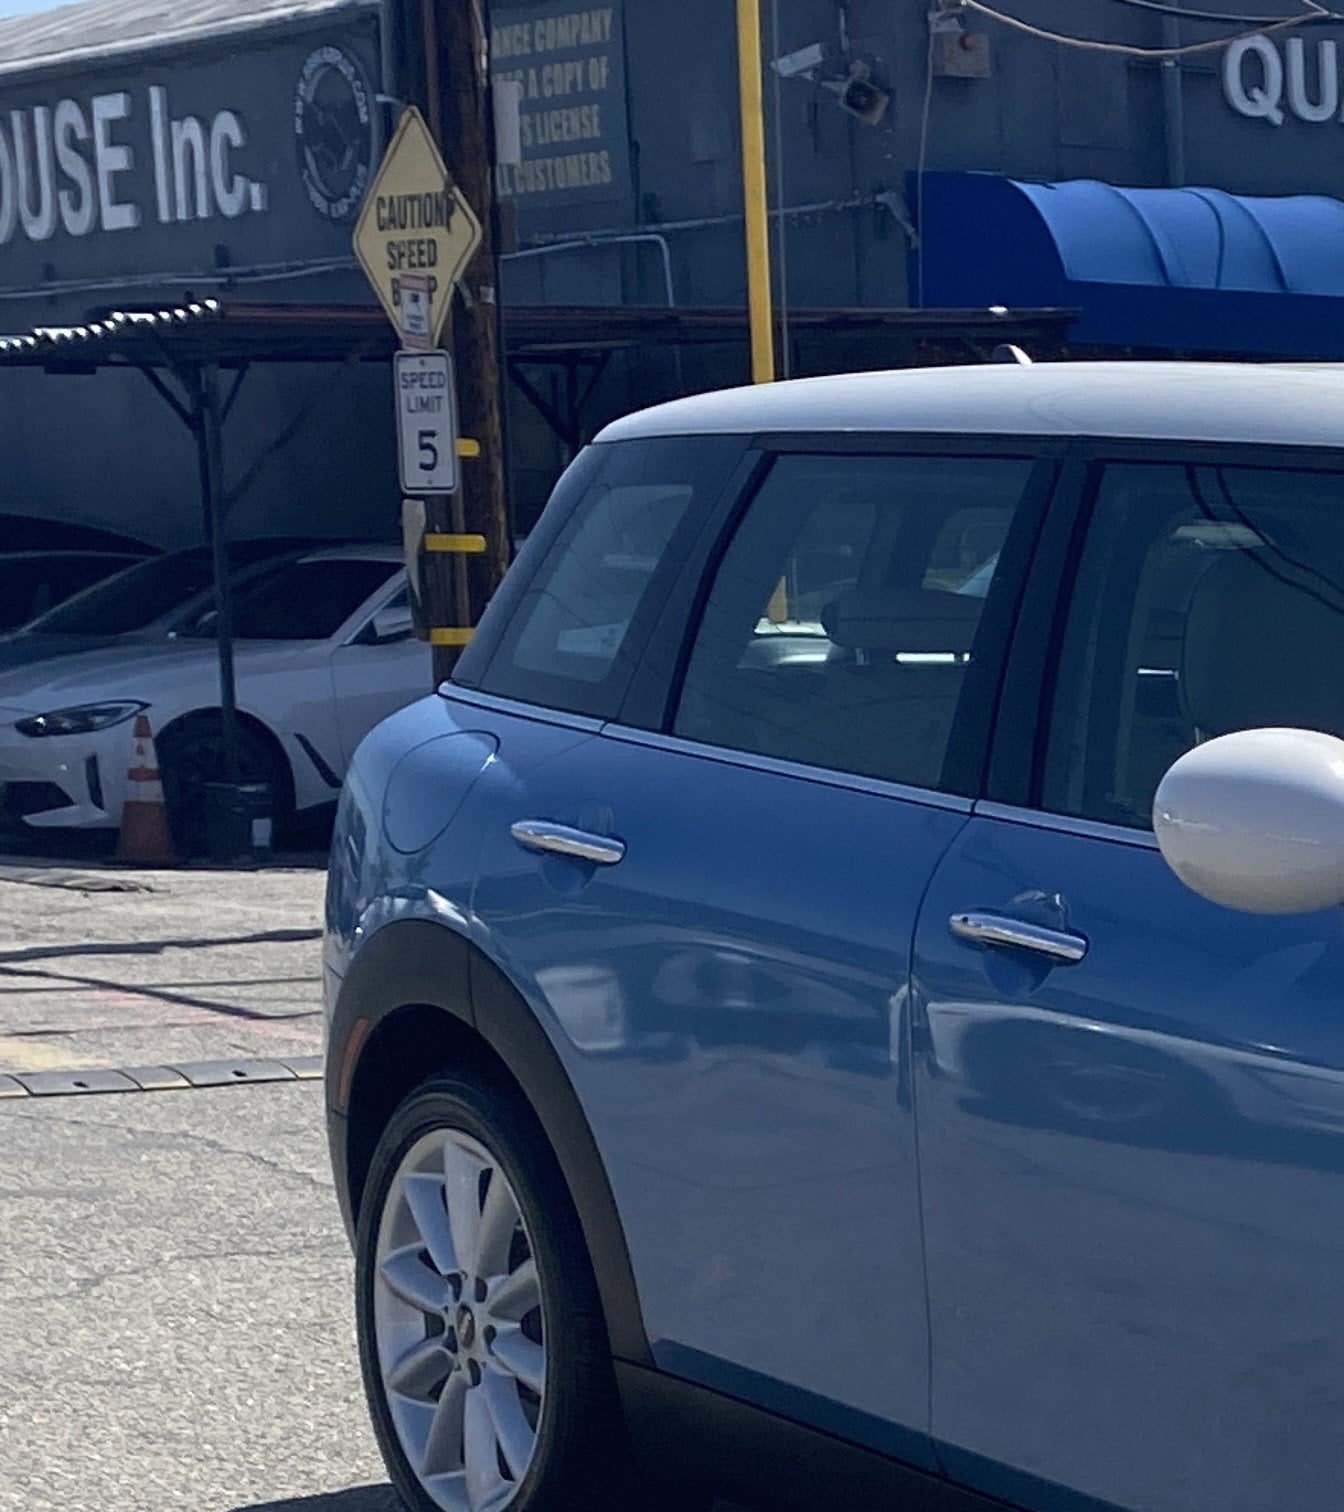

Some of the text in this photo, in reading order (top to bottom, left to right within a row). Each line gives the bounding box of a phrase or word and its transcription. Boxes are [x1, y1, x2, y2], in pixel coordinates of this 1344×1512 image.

[534, 8, 613, 52] COMPANY
[542, 60, 584, 97] COPY
[588, 56, 610, 90] OF
[536, 104, 600, 144] LICENSE
[149, 85, 268, 222] Inc.
[514, 150, 612, 194] CUSTOMERS
[376, 191, 452, 232] CAUTION
[387, 238, 438, 270] SPEED
[391, 274, 438, 307] BP
[401, 371, 446, 389] SPEED
[406, 395, 443, 413] LIMIT
[418, 429, 438, 471] 5
